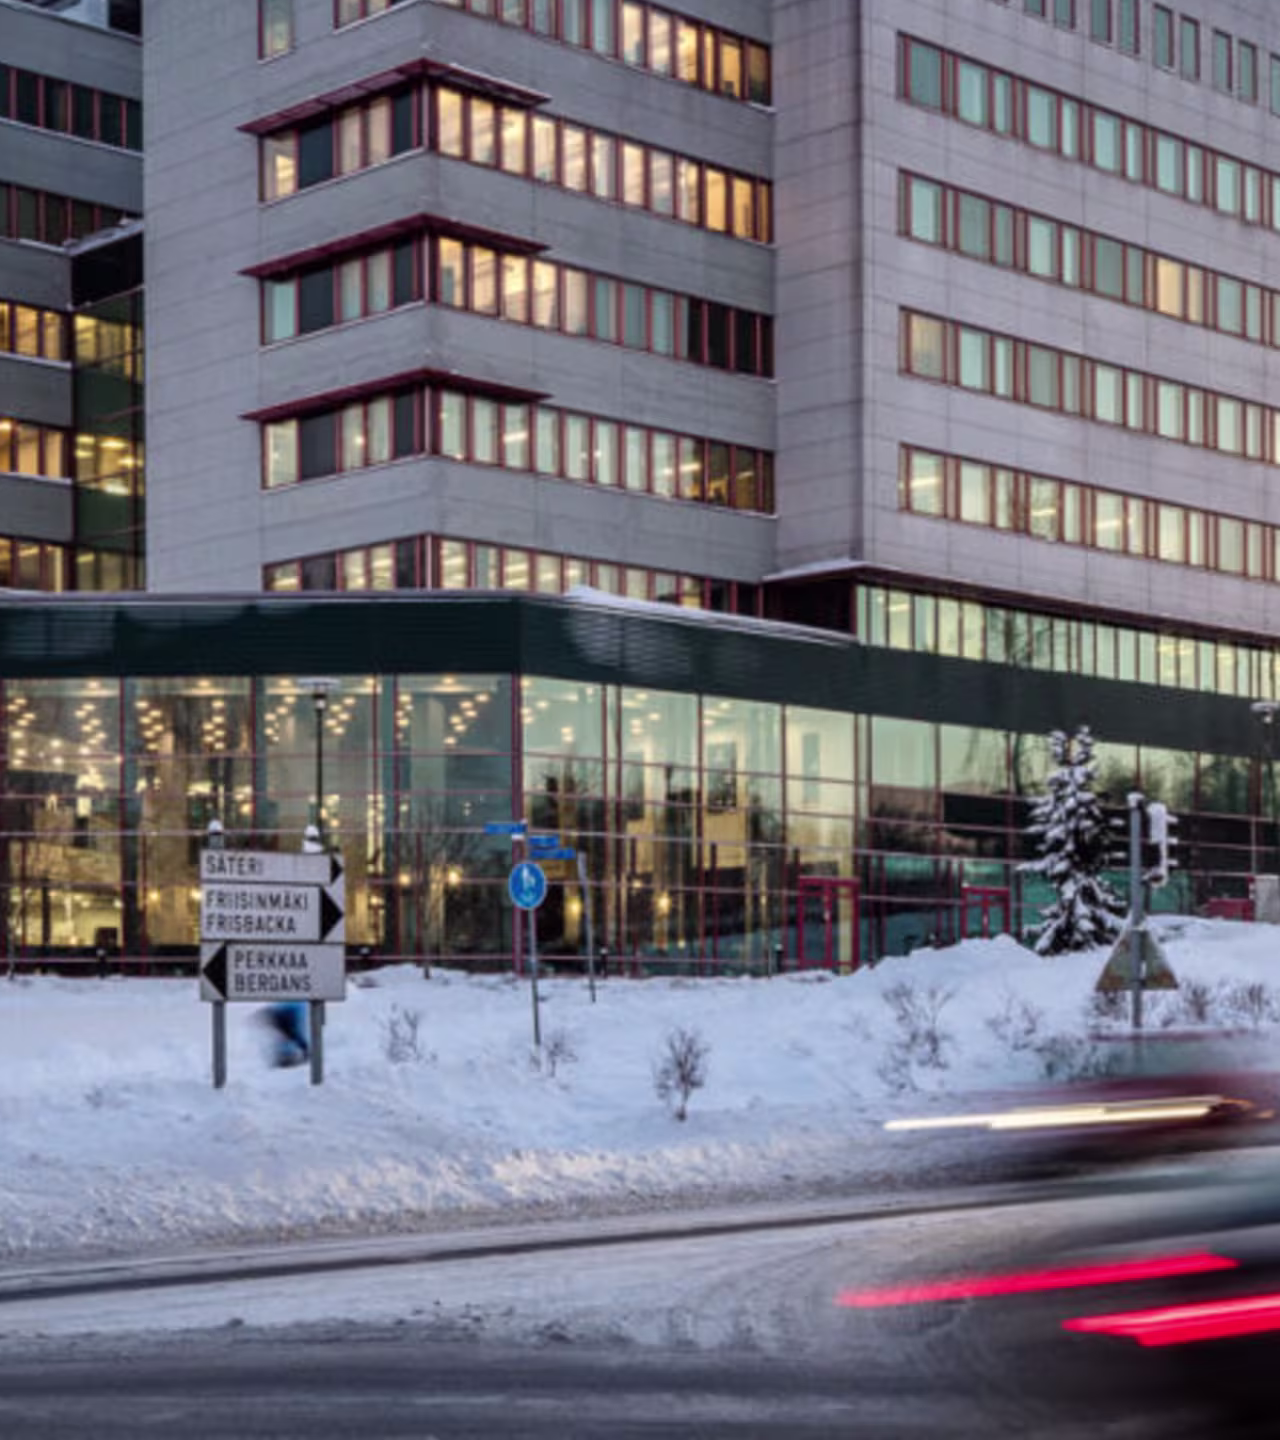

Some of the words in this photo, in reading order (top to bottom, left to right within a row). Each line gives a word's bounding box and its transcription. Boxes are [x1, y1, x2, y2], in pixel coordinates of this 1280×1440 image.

[206, 854, 263, 876] SÄTERI
[206, 889, 308, 911] FRIISINMÄKI
[206, 913, 296, 934] FRISBACKA
[234, 950, 308, 969] PERKKAA
[234, 972, 312, 993] BERGANS
